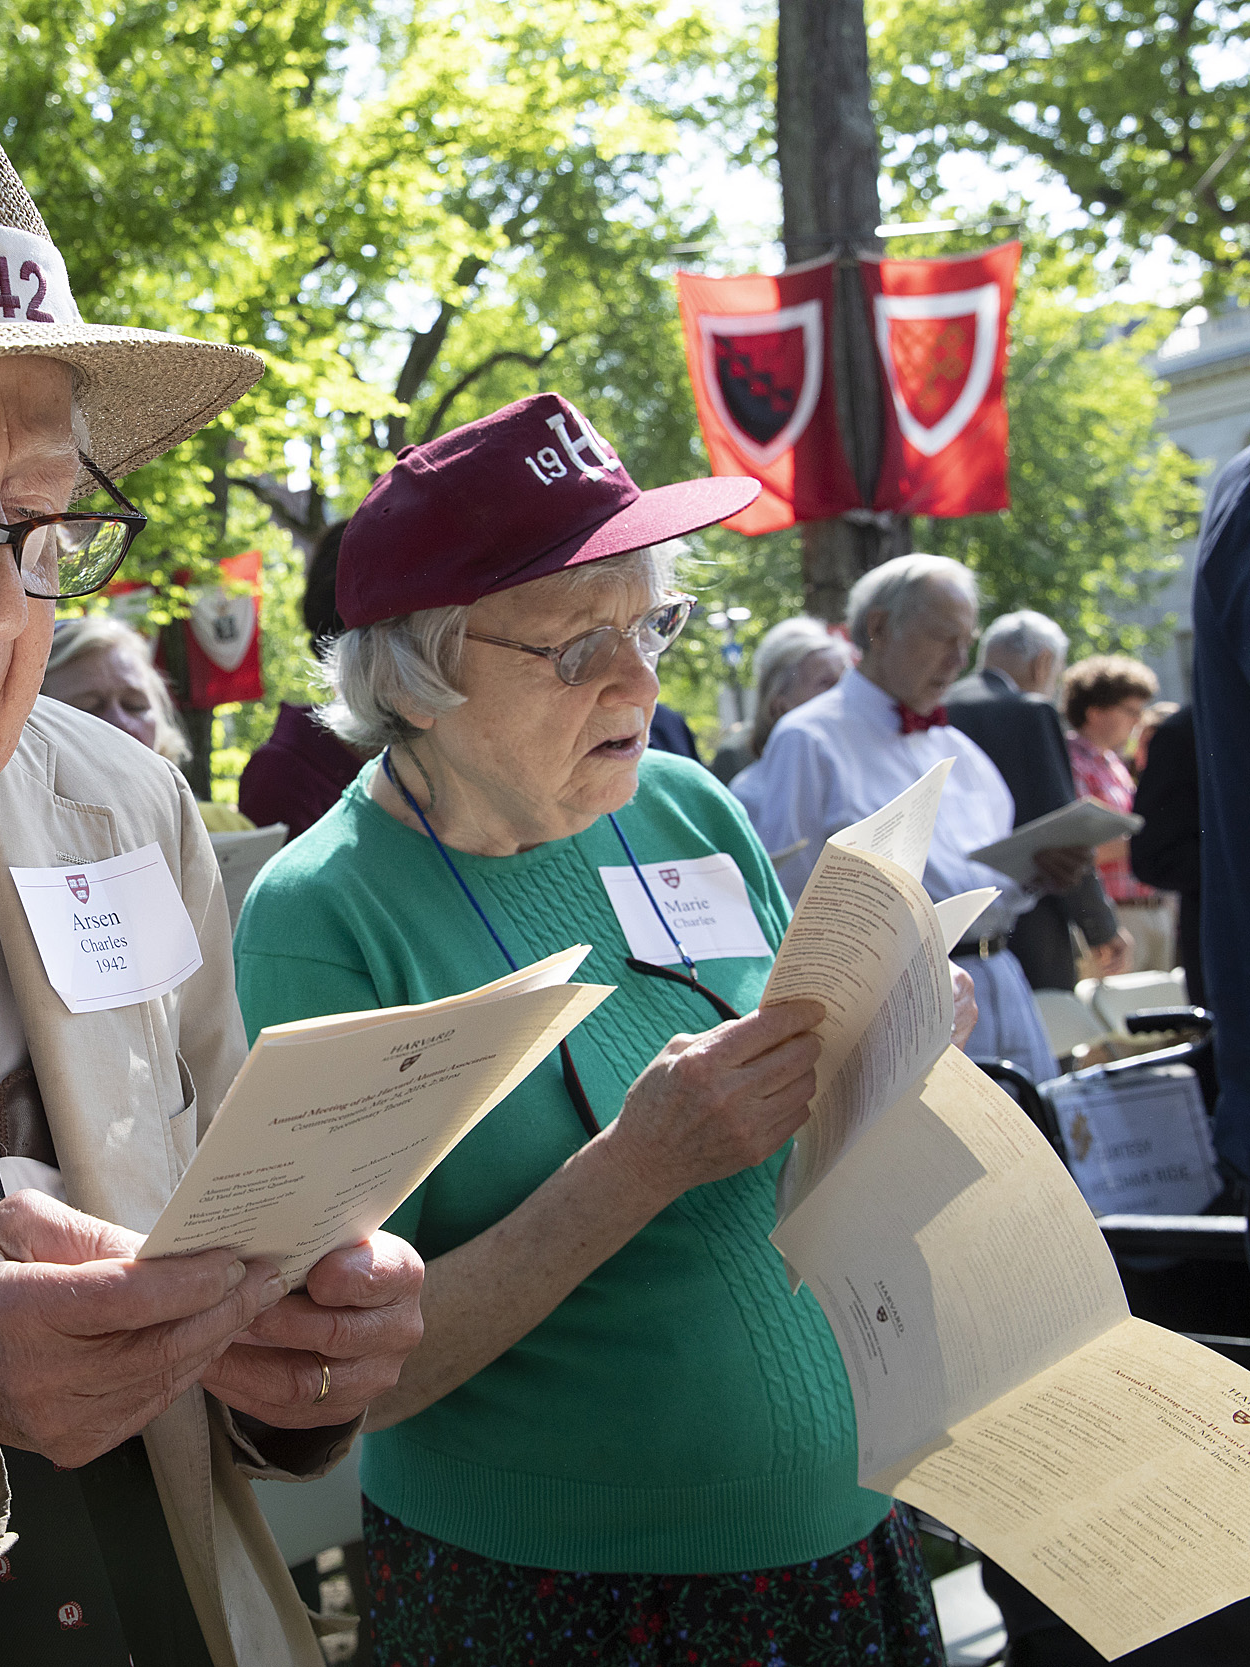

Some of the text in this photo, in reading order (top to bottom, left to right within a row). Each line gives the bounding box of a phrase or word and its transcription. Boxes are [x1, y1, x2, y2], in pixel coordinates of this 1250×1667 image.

[524, 447, 568, 486] 19
[871, 874, 891, 888] Harvard
[663, 897, 711, 915] Marie
[853, 902, 873, 914] Harvard
[72, 911, 121, 932] Arsen
[672, 916, 717, 929] Charles
[80, 935, 128, 954] Charles
[95, 956, 128, 974] 1942
[390, 1029, 456, 1054] HARVARD
[268, 1111, 307, 1127] Annual
[307, 1102, 349, 1118] Meeting
[349, 1098, 362, 1108] of
[361, 1093, 376, 1104] the
[376, 1078, 415, 1101] Harvard
[413, 1067, 448, 1083] Alumni
[255, 1161, 295, 1174] PROGRAM
[203, 1185, 232, 1196] Alumni
[183, 1217, 215, 1228] Harvard
[878, 1280, 904, 1333] HARVARD
[1228, 1388, 1250, 1405] HA
[1112, 1369, 1245, 1449] Annual Meeting of the Harvard
[1128, 1386, 1197, 1432] Commencement,
[1198, 1429, 1218, 1445] May
[1232, 1454, 1250, 1468] 201
[1157, 1414, 1240, 1473] Tercentenary Theatre
